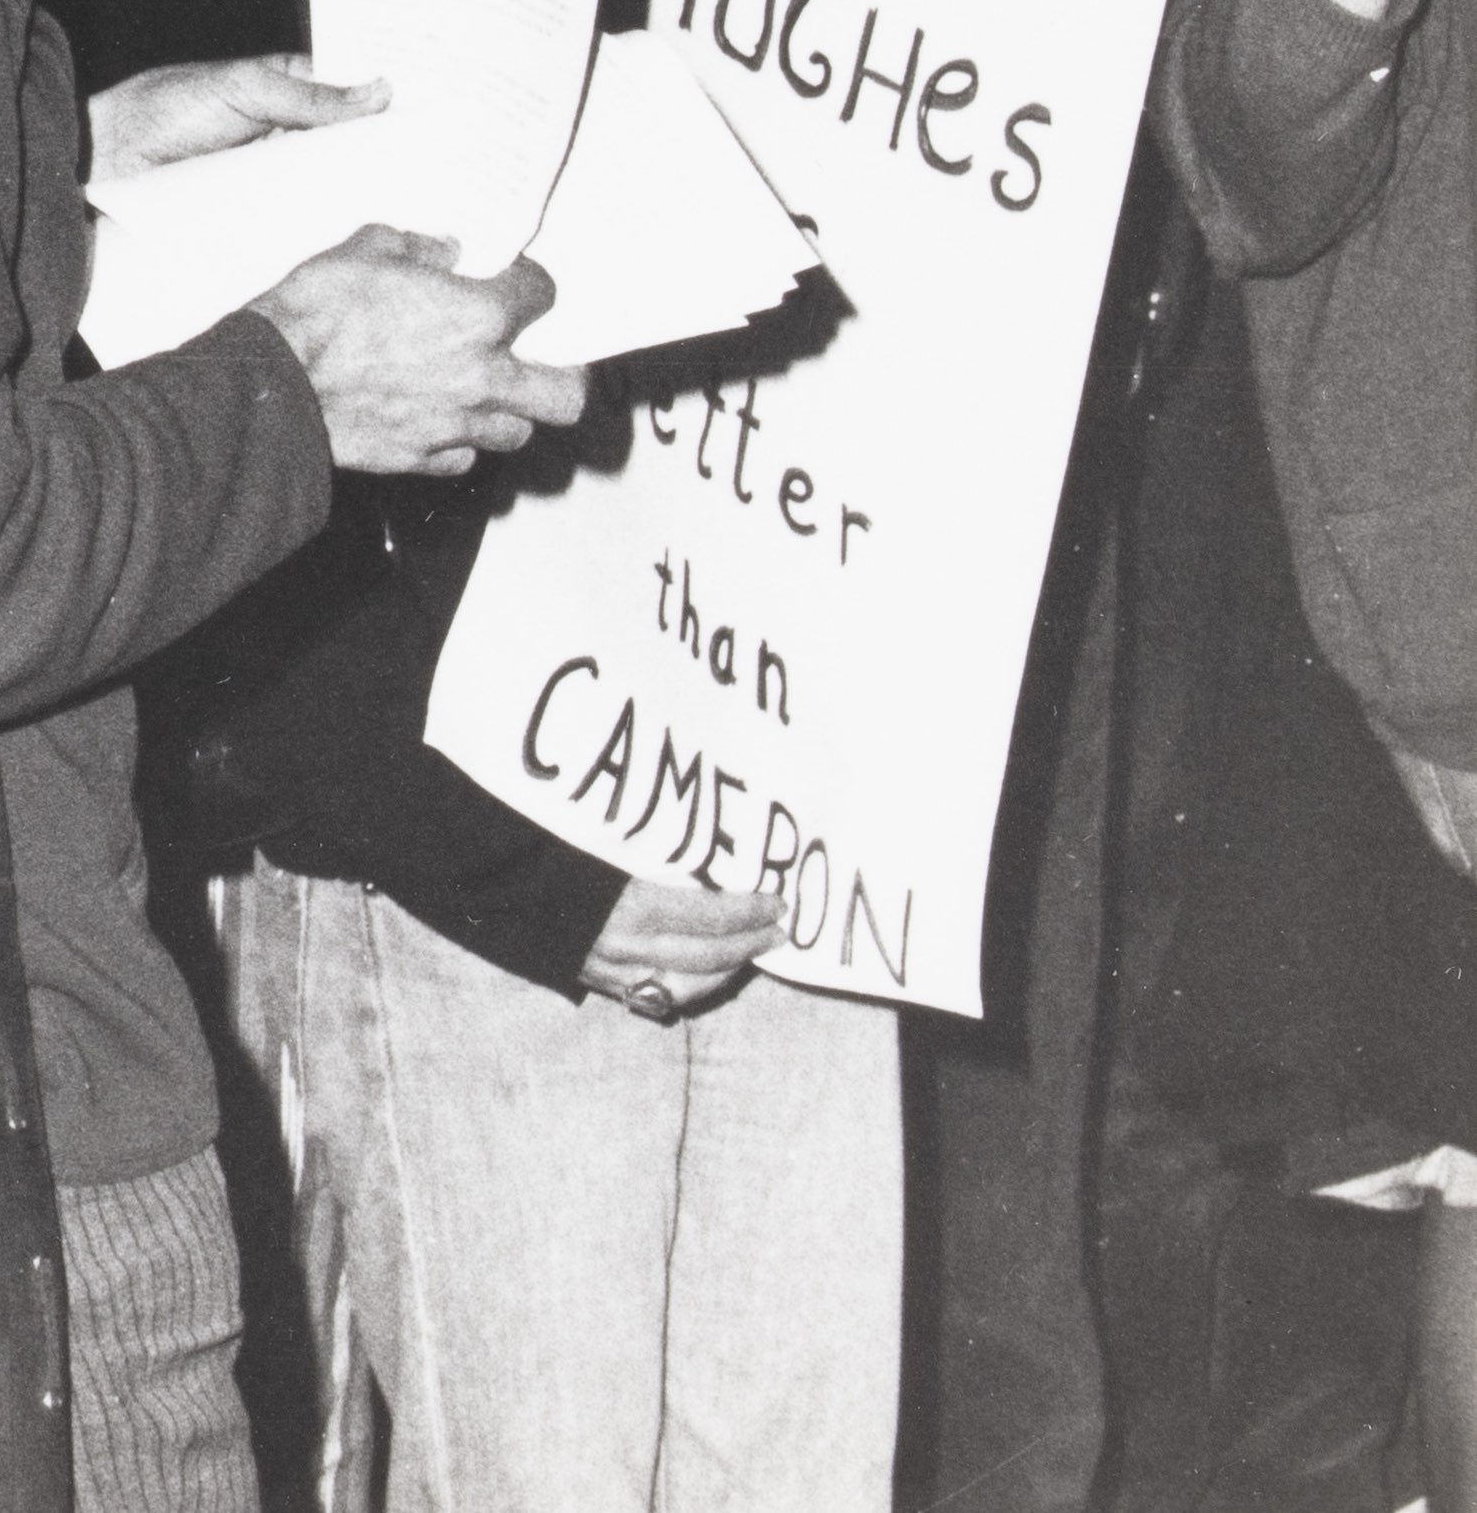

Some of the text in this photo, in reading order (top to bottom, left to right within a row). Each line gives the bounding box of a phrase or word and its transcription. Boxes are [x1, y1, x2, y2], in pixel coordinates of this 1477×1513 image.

[649, 376, 873, 567] etter
[652, 544, 792, 729] than
[520, 656, 917, 990] CAMERON
